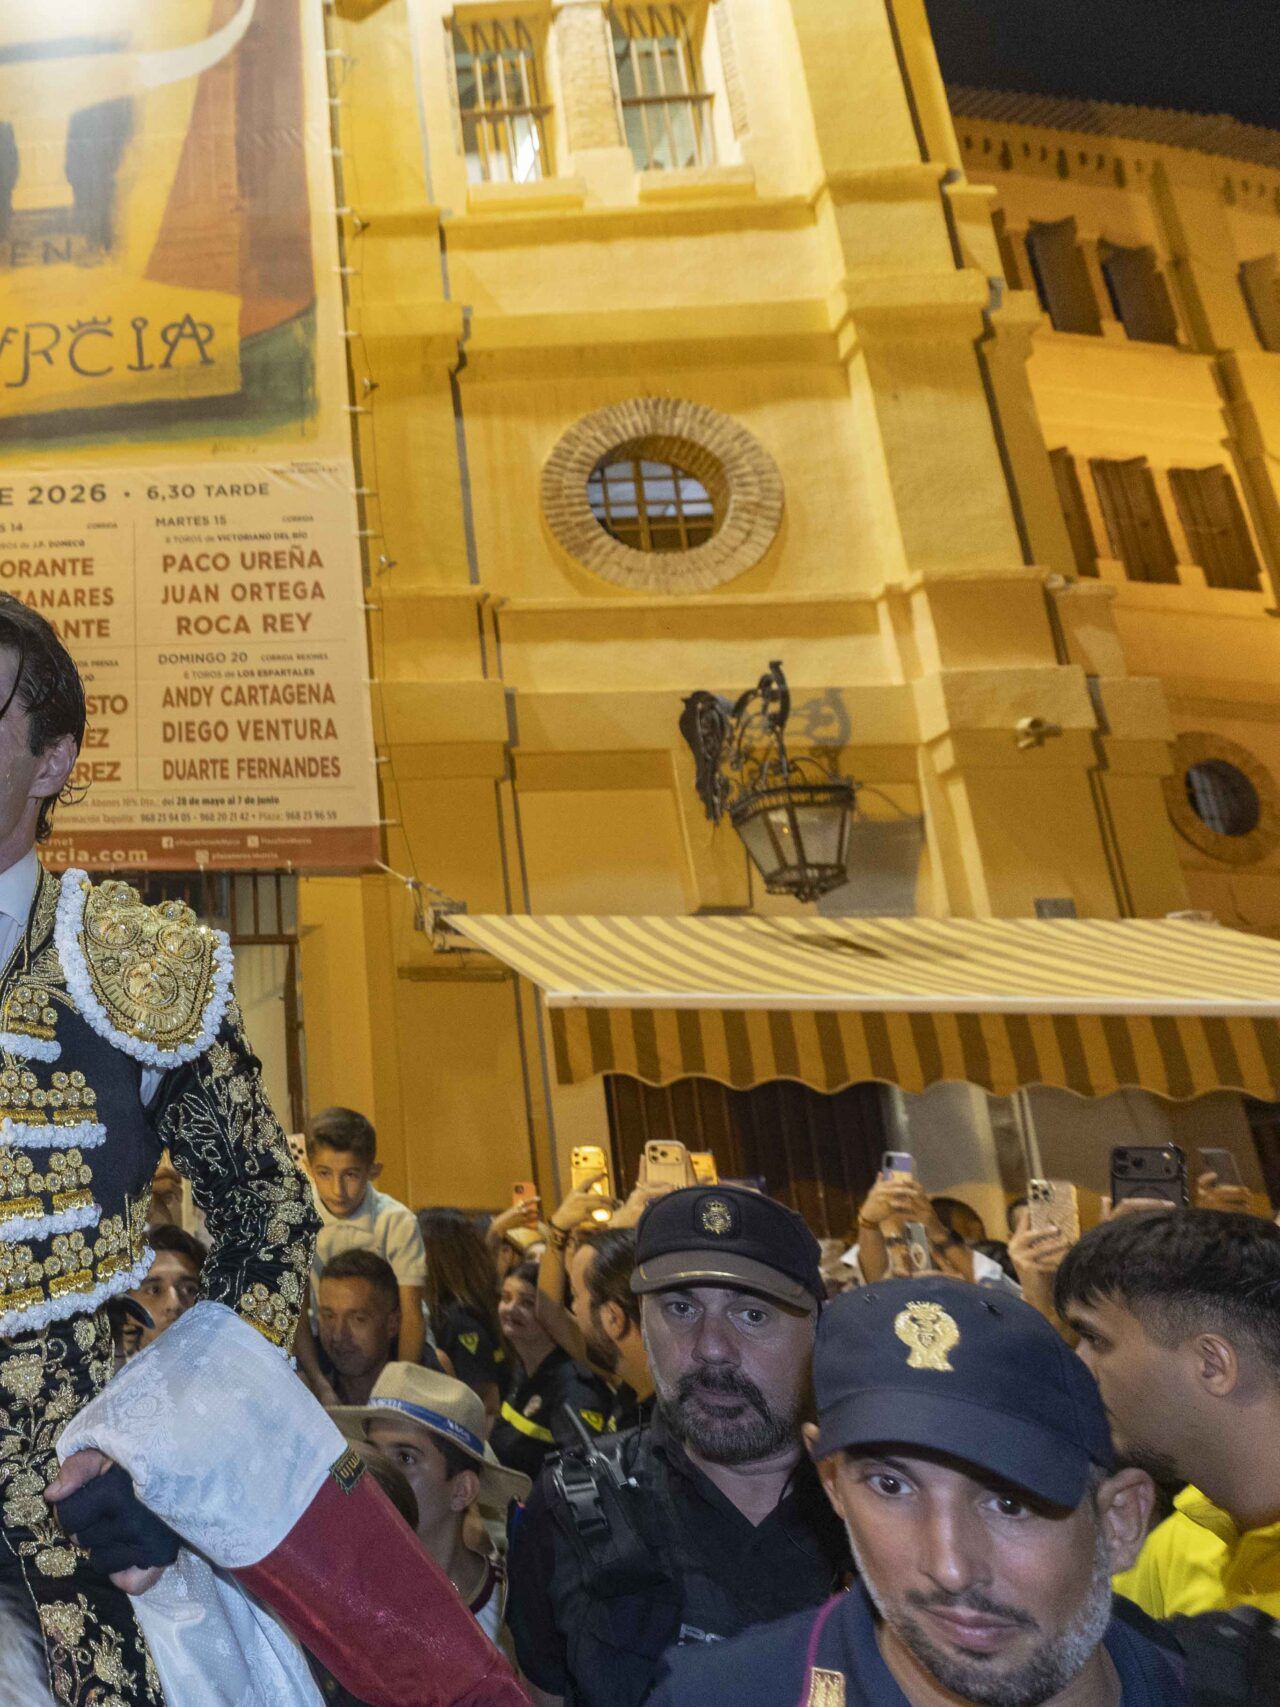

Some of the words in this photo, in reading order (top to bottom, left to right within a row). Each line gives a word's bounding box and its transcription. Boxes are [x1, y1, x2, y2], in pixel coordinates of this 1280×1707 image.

[27, 484, 108, 505] 2026
[147, 484, 196, 501] 6,30
[203, 482, 270, 498] TARDE
[11, 522, 24, 533] 14
[155, 515, 210, 527] MARTES
[214, 515, 227, 526] 15
[174, 534, 203, 544] TOROS
[217, 531, 271, 542] VICTORIANO
[274, 531, 290, 540] DEL
[162, 552, 231, 574] PACO
[240, 544, 324, 571] UREÑA
[161, 583, 220, 605] JUAN
[230, 580, 326, 602] ORTEGA
[176, 614, 251, 637] ROCA
[262, 611, 312, 634] REY
[157, 652, 227, 666] DOMINGO
[231, 651, 249, 664] 20
[237, 668, 256, 678] LOS
[257, 667, 316, 678] ESPARTALES
[162, 684, 214, 708] ANDY
[220, 681, 337, 707] CARTAGENA
[162, 719, 230, 744] DIEGO
[236, 716, 339, 742] VENTURA
[162, 757, 230, 781] DUARTE
[236, 755, 342, 780] FERNANDES
[201, 797, 226, 807] mayo
